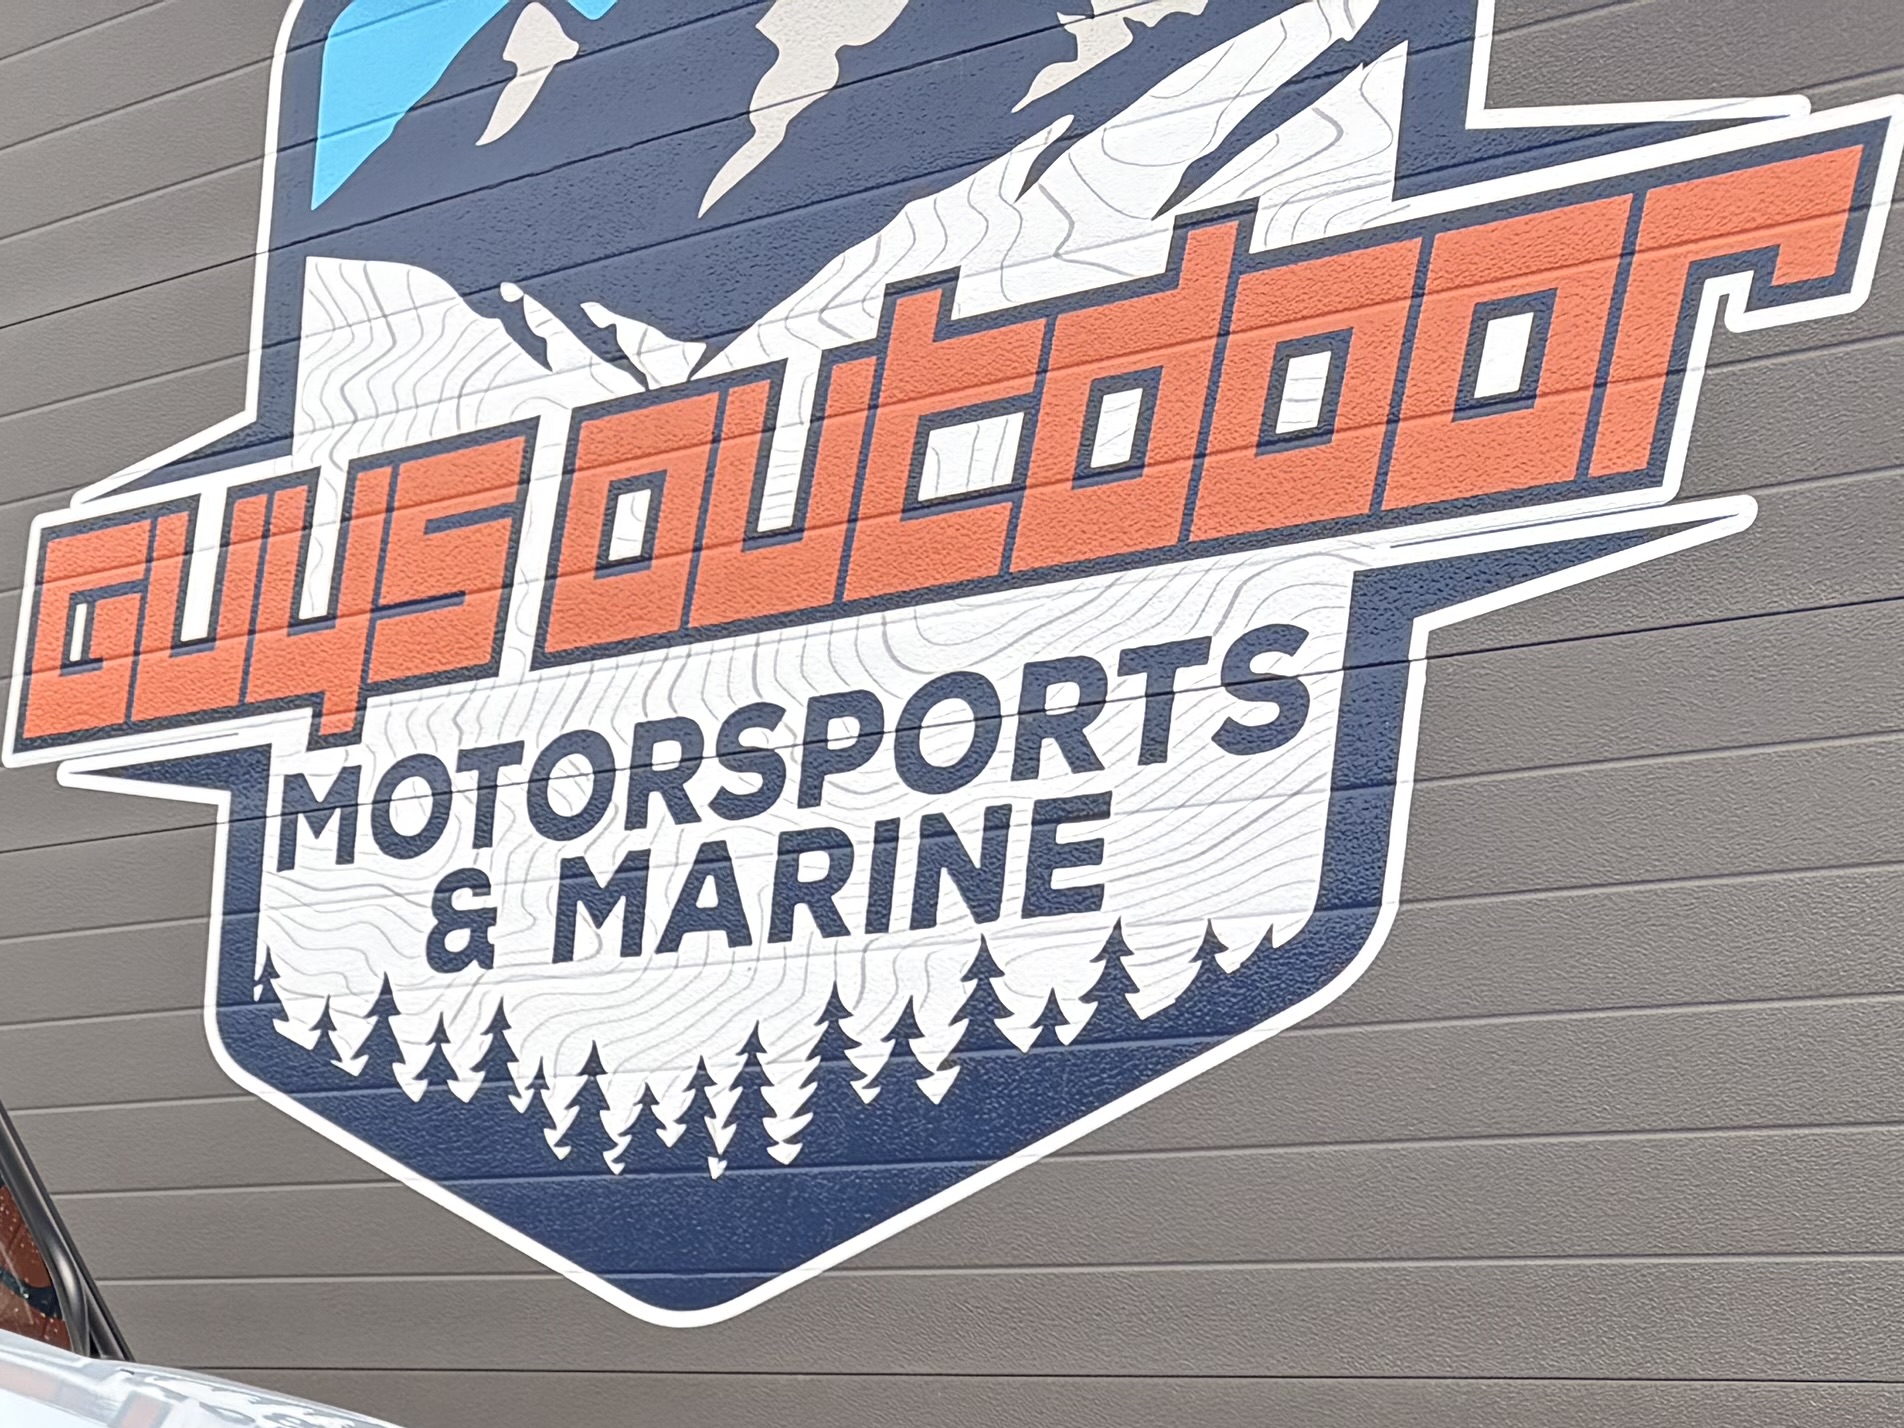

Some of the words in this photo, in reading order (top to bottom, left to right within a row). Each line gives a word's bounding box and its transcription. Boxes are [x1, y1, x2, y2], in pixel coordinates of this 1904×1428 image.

[276, 622, 1315, 875] MOTORSPORTS
[424, 867, 498, 973] &
[551, 790, 1114, 967] MARINE
